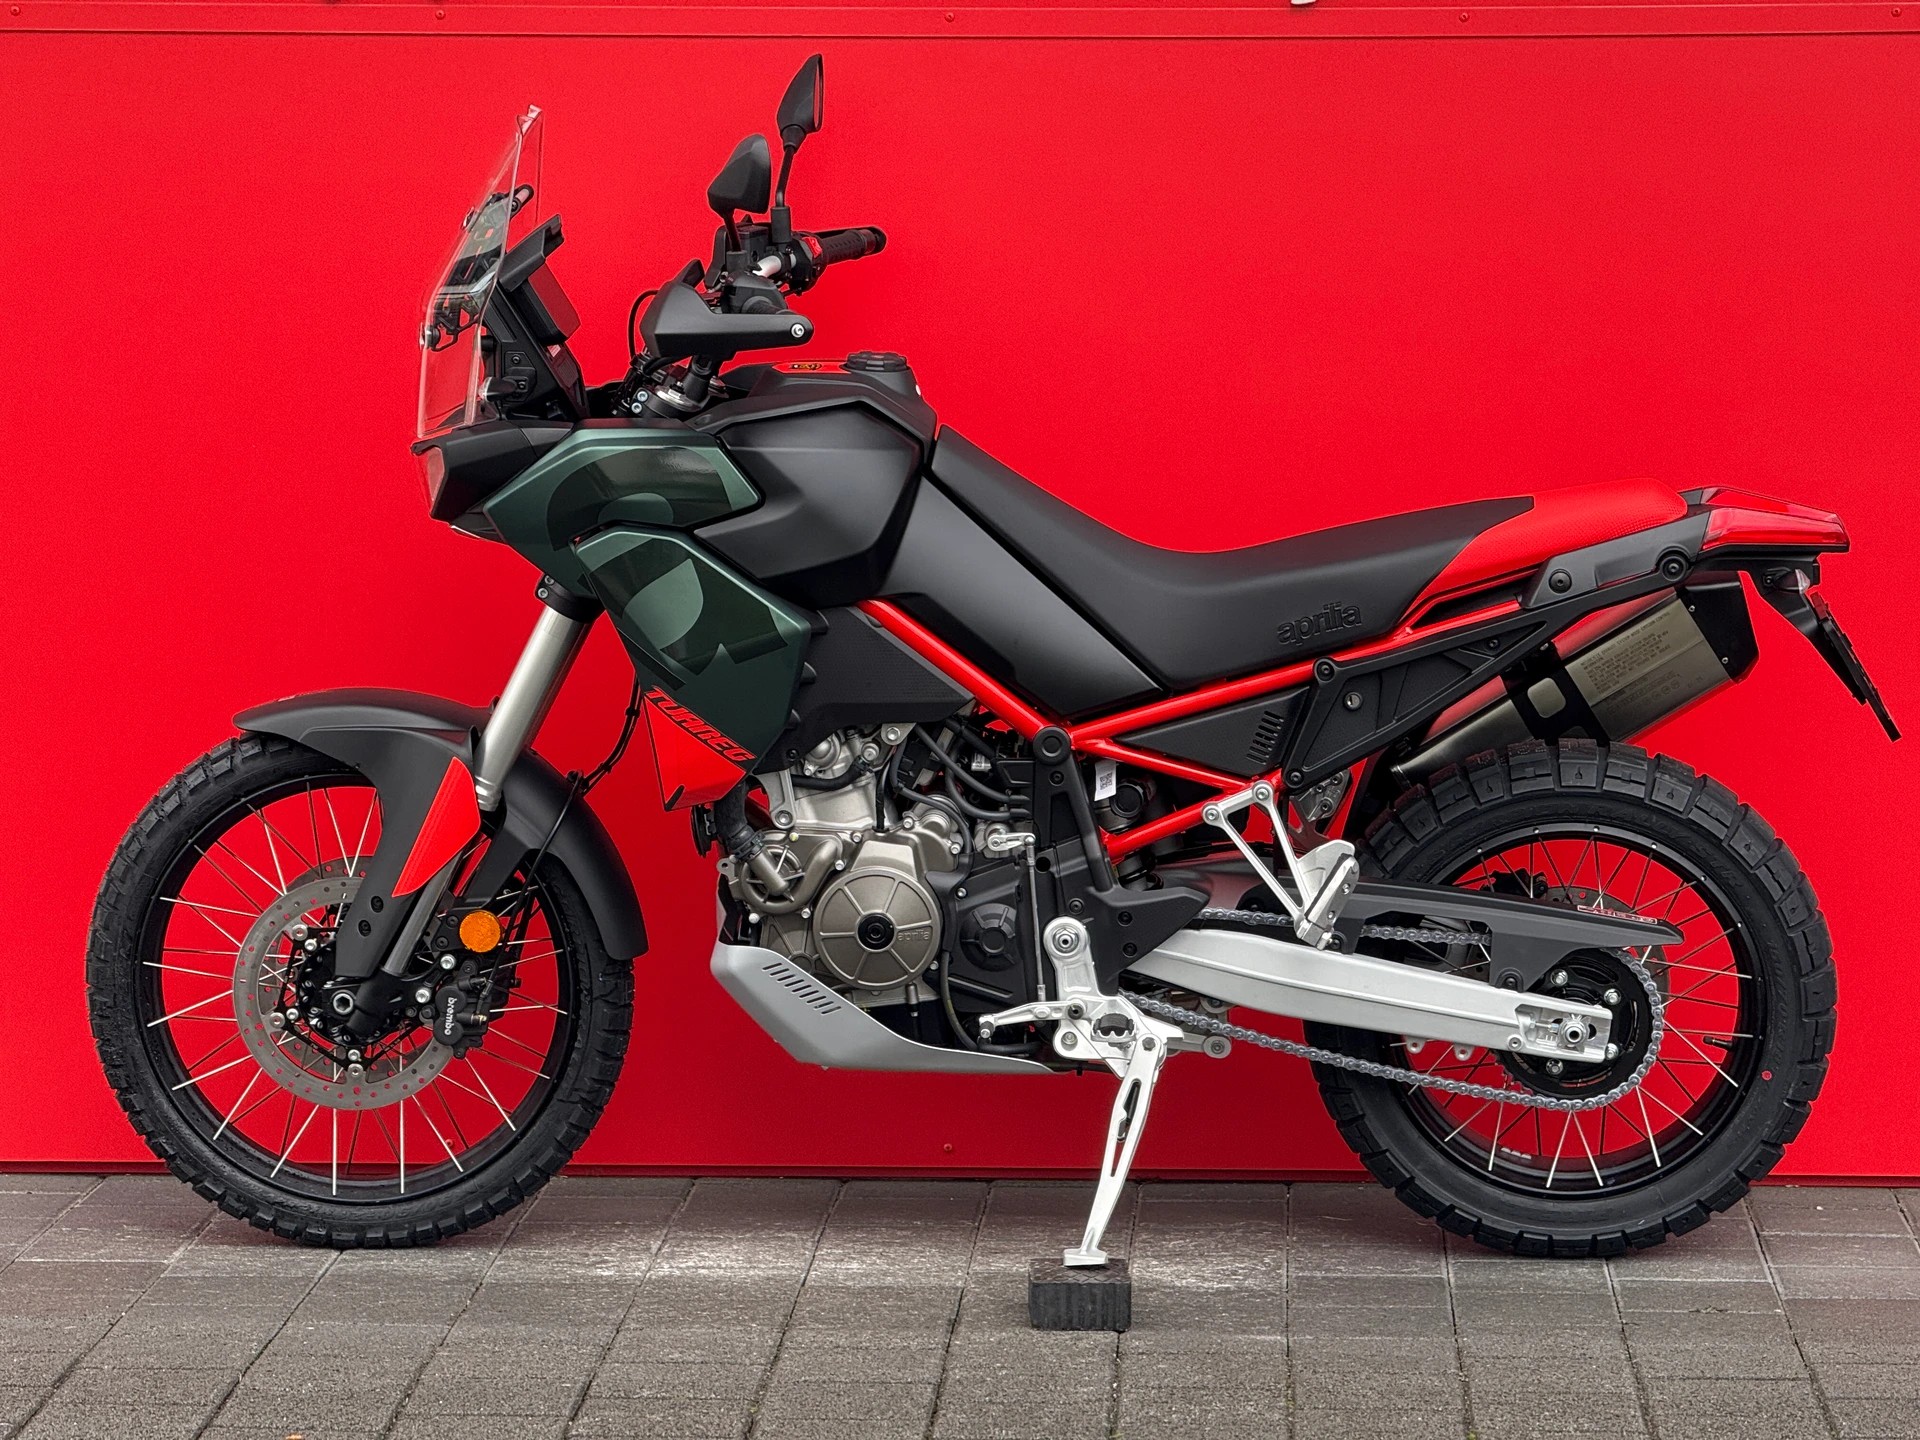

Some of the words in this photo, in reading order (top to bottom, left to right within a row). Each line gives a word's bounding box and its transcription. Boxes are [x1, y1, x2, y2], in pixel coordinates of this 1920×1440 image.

[1277, 601, 1362, 645] aprilia
[643, 684, 758, 762] TUAREG
[897, 929, 930, 941] aprilia
[444, 997, 457, 1036] brembo
